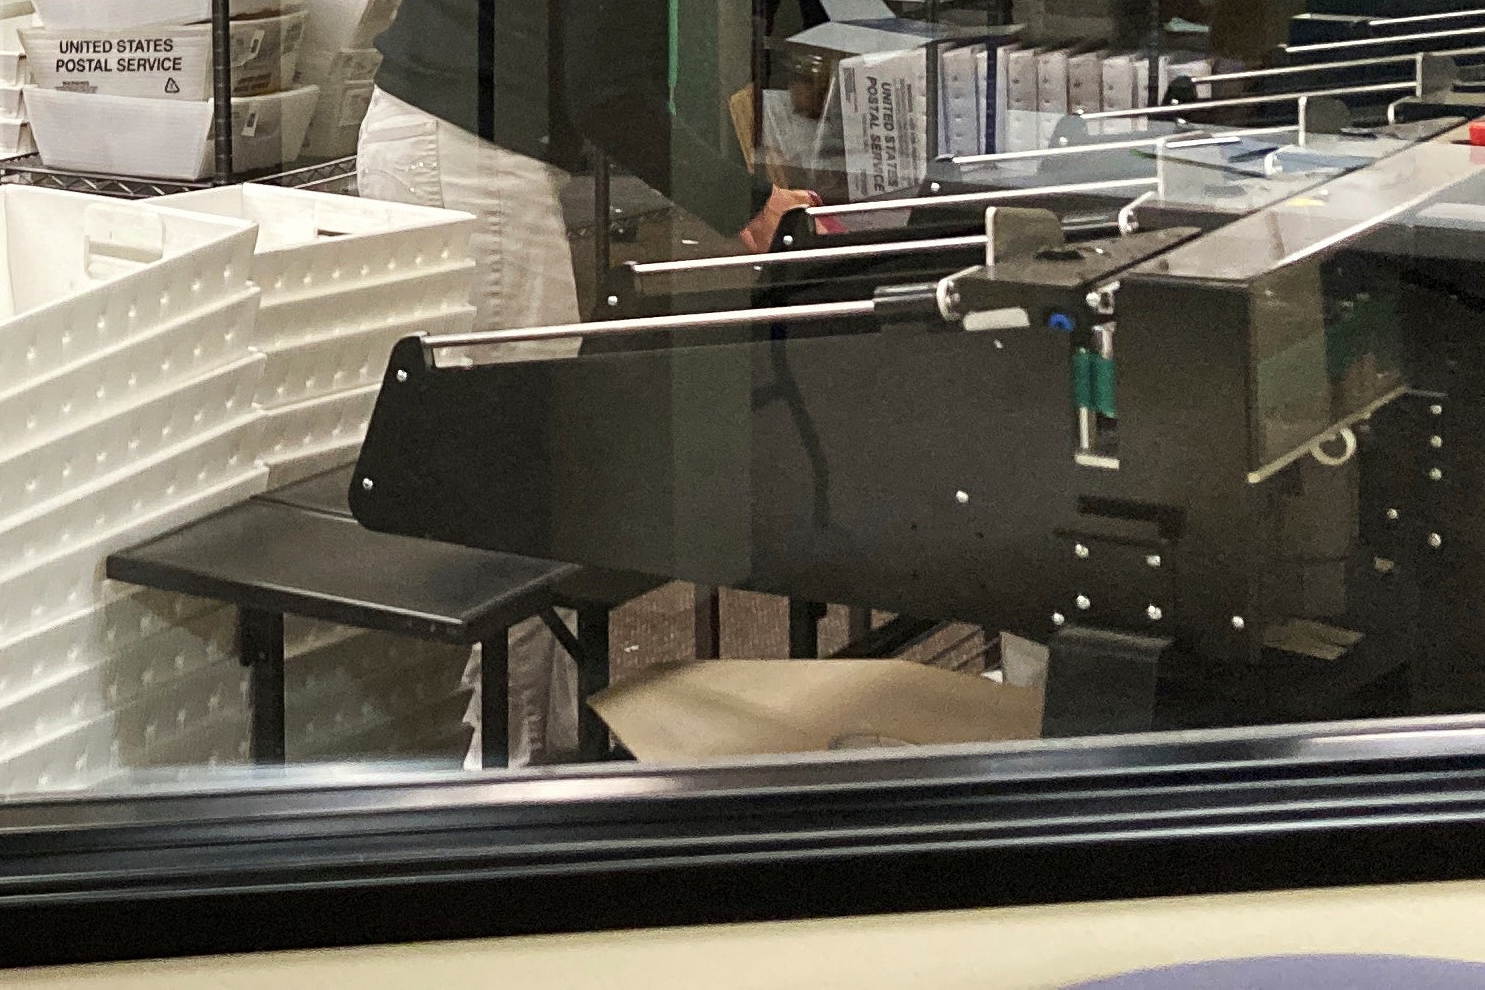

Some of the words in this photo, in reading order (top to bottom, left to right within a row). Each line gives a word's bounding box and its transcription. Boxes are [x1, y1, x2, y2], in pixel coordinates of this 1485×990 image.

[55, 58, 113, 73] POSTAL
[116, 57, 183, 72] SERVICE
[59, 40, 113, 54] UNITED
[116, 38, 174, 53] STATES
[866, 76, 880, 130] POSTAL
[881, 82, 895, 132] UNITED
[870, 134, 885, 192] SERVICE
[884, 135, 899, 188] STATES
